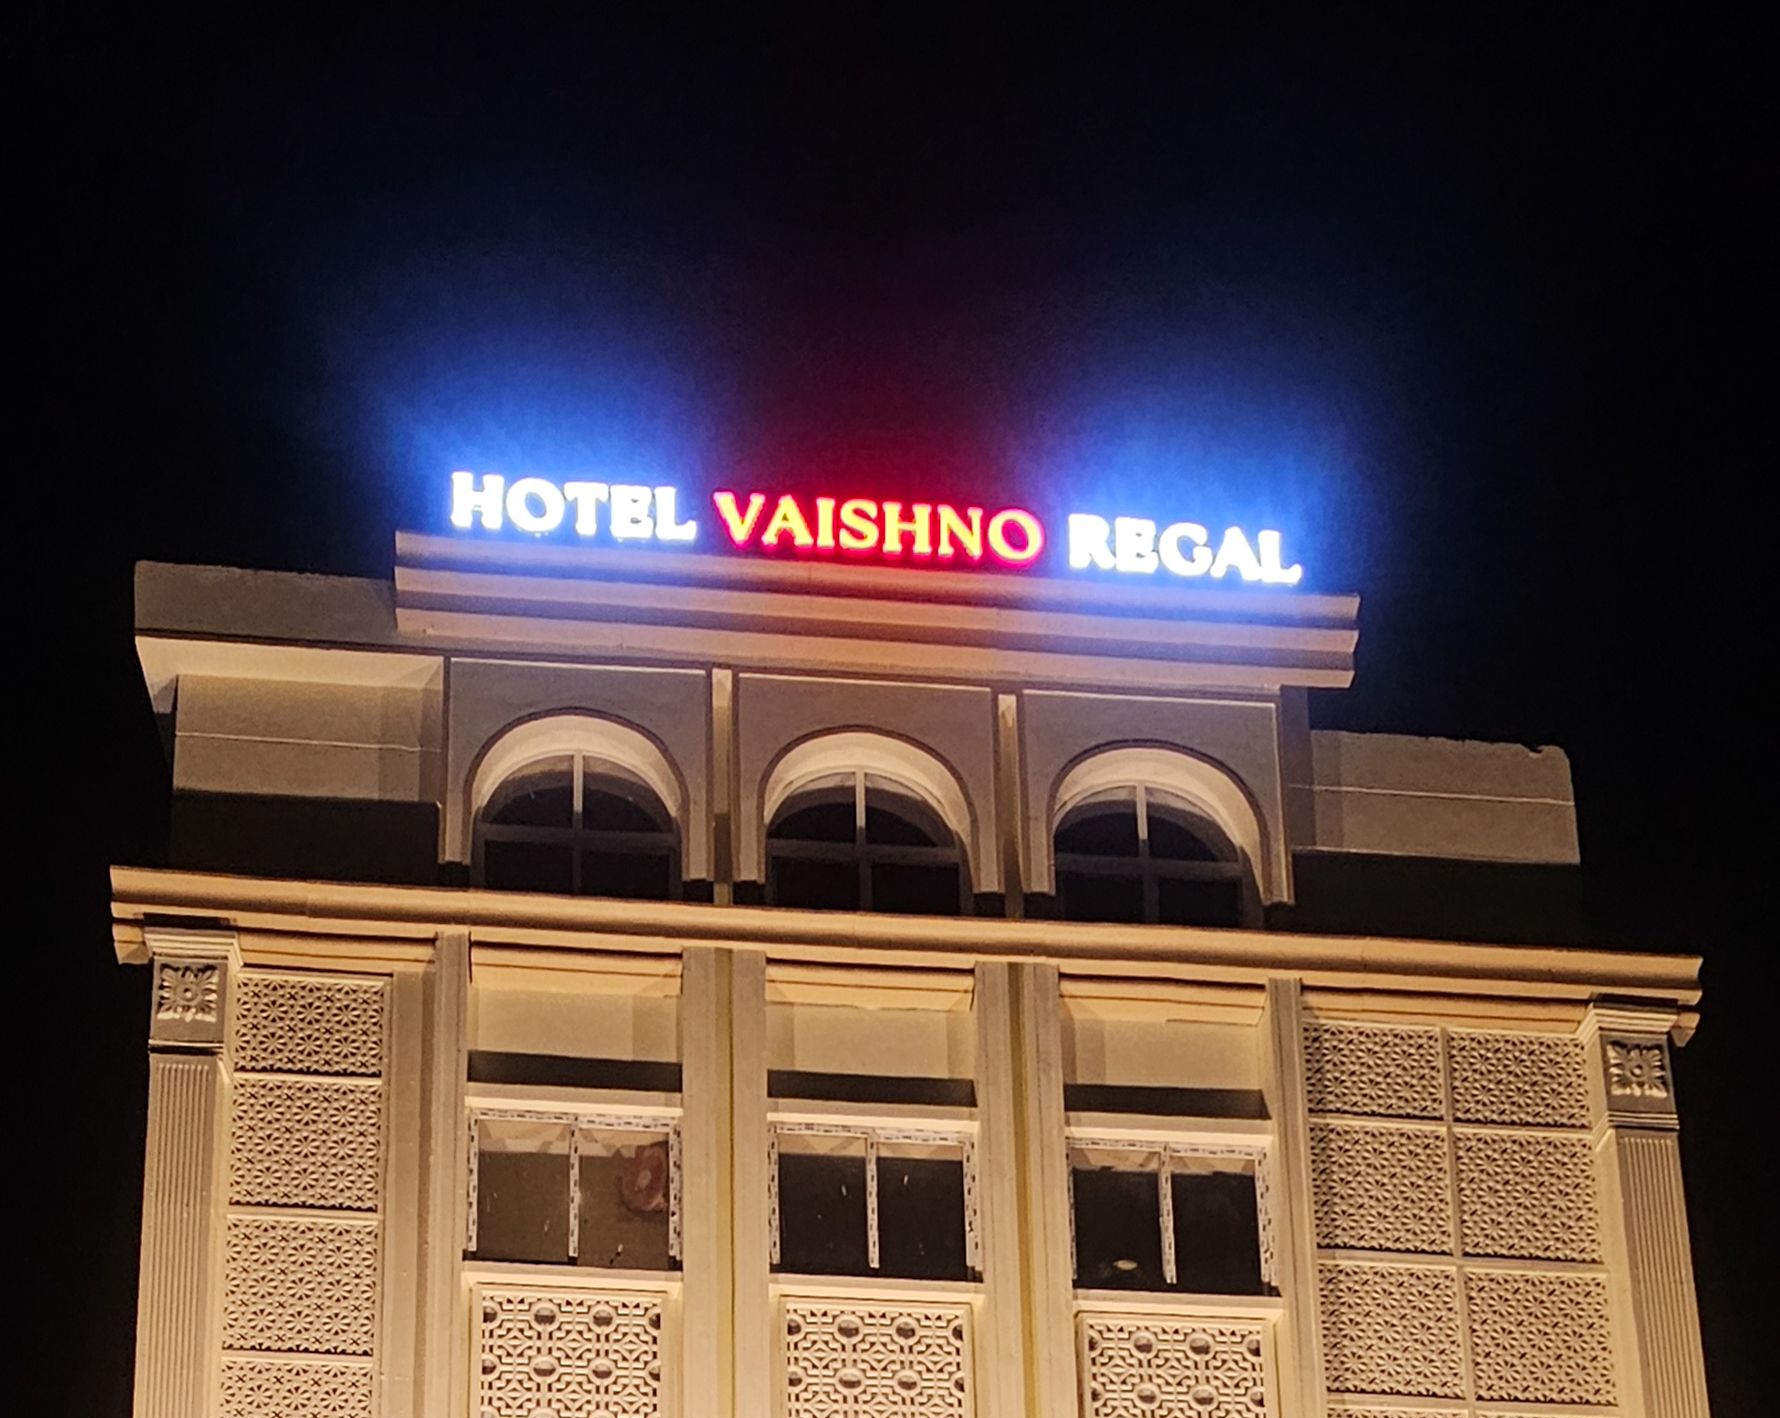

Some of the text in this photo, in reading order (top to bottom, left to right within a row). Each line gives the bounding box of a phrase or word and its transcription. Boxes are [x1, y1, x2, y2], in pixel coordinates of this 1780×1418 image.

[450, 471, 1302, 586] HOTEL VAISHNO REGAL
